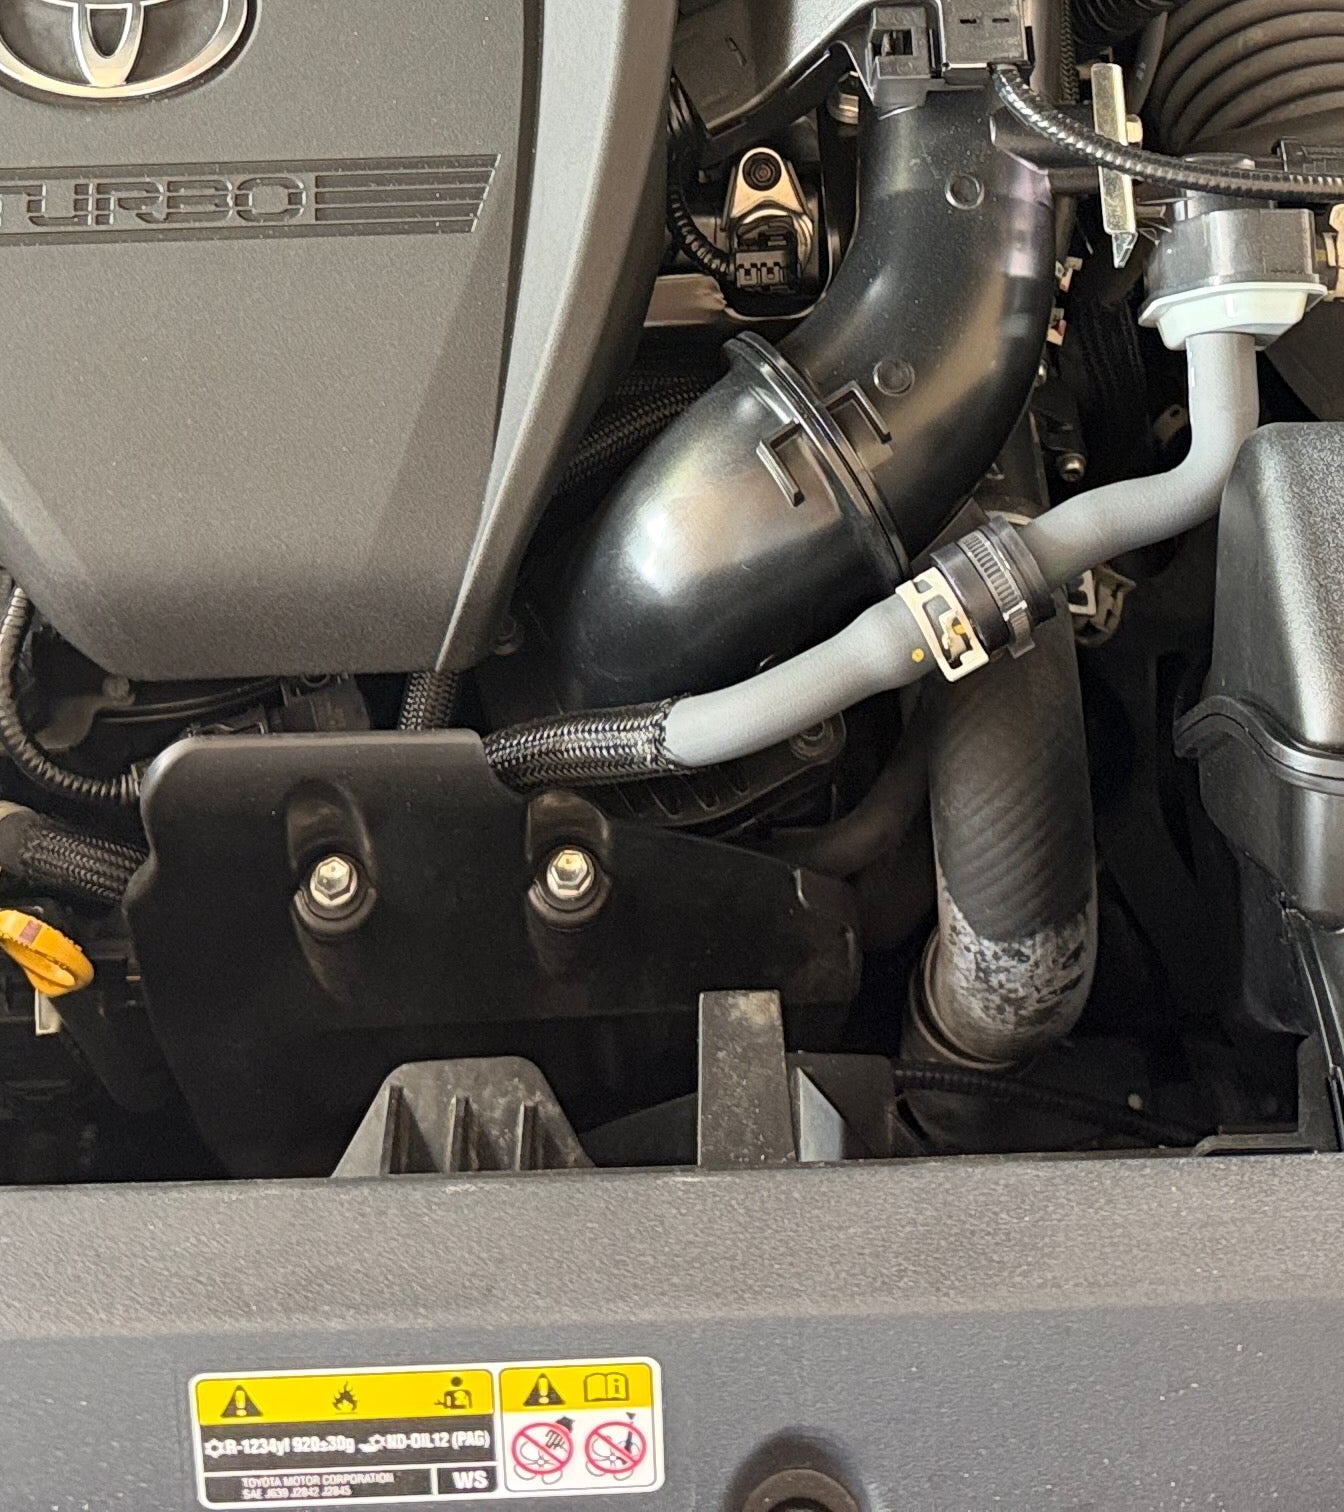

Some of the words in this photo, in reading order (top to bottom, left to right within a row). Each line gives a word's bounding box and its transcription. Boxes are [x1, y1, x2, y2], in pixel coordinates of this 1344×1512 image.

[452, 1430, 490, 1450] (PAG)
[241, 1476, 282, 1488] TOYOTA
[283, 1474, 320, 1486] MOTOR
[322, 1473, 394, 1485] CORPORATION
[452, 1470, 489, 1489] WS
[241, 1488, 263, 1500] SAE
